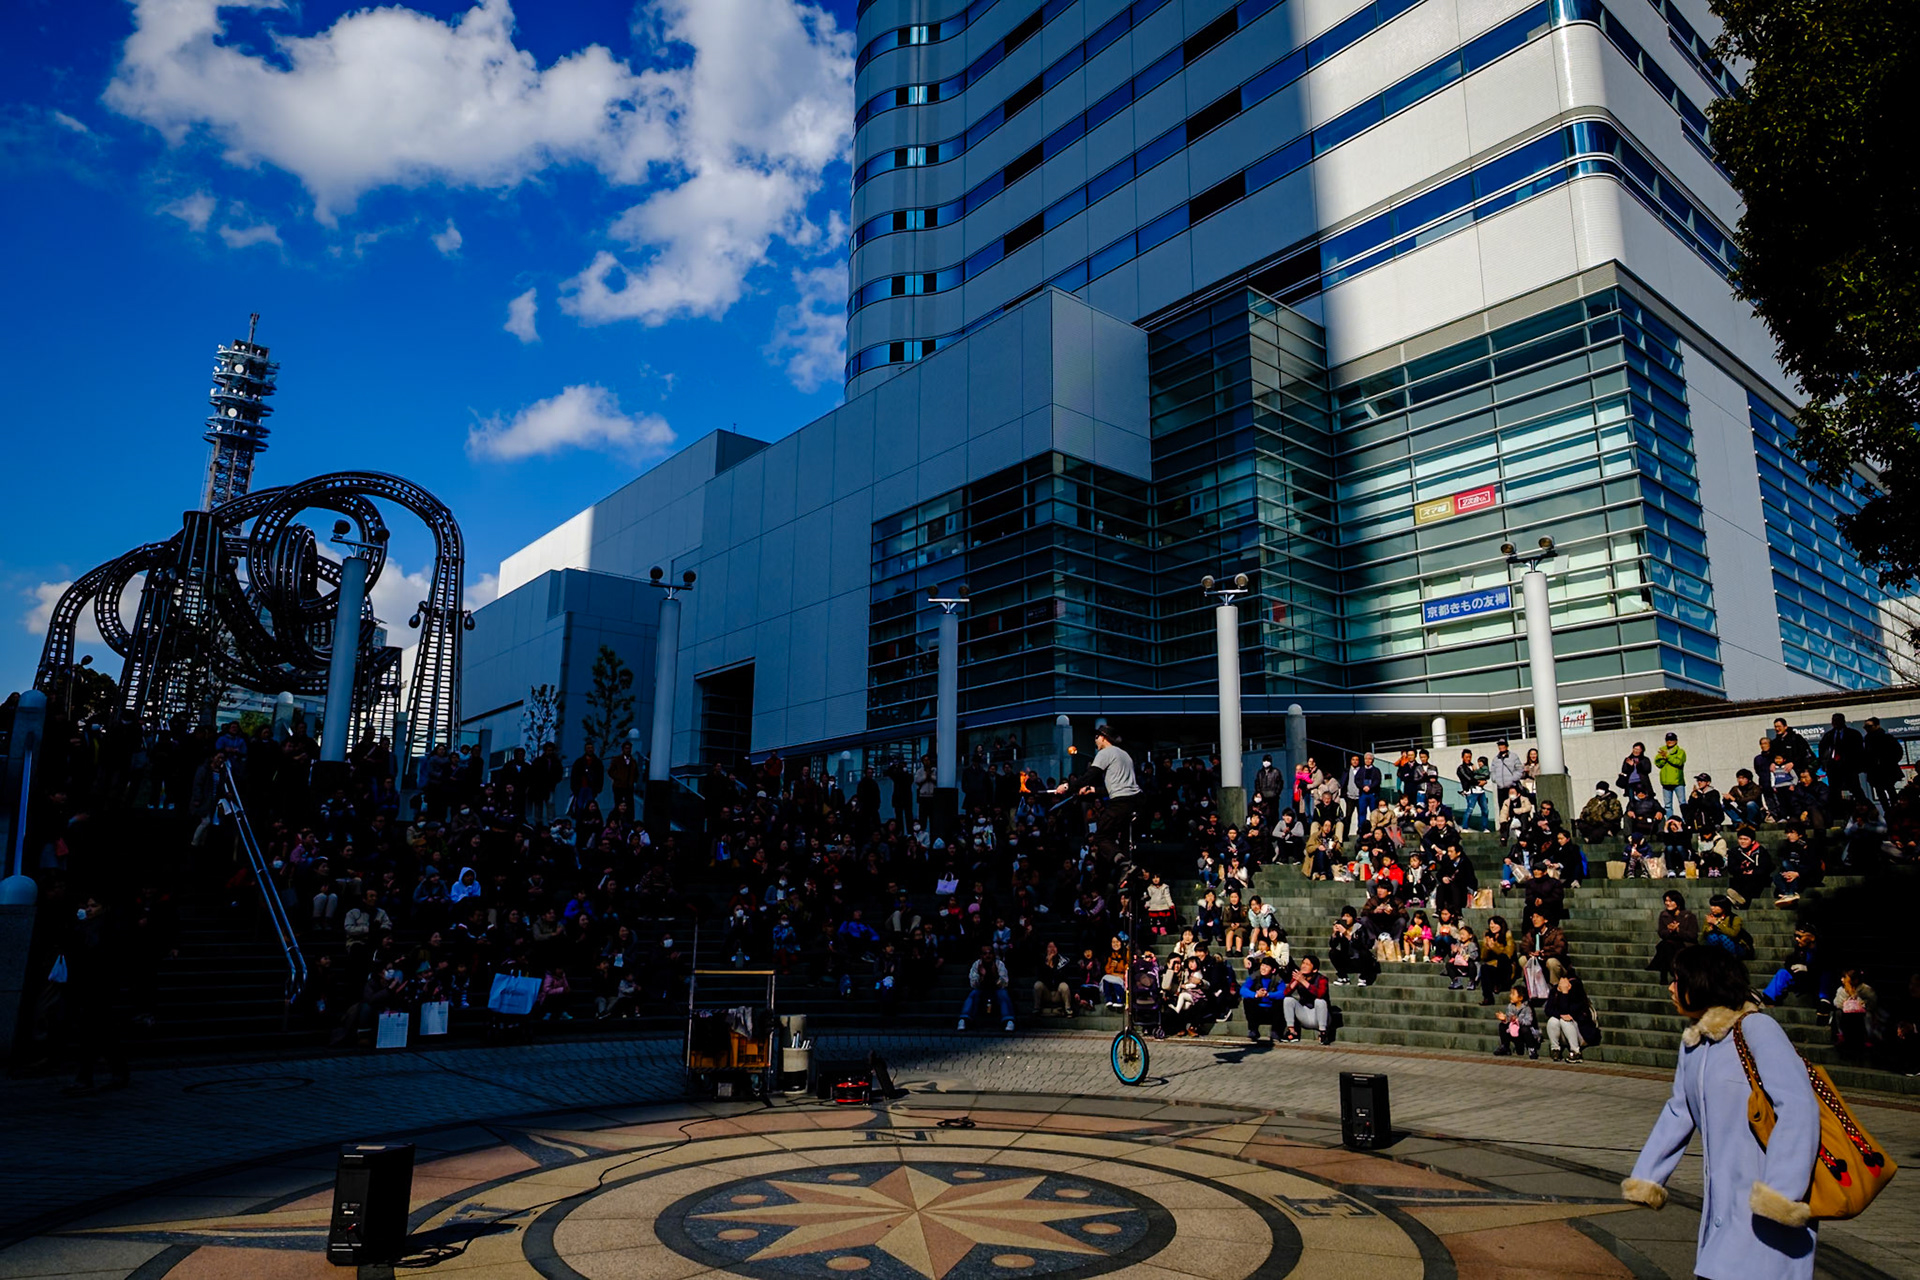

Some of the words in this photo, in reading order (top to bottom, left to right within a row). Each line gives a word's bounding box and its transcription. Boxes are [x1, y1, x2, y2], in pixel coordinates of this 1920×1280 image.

[1426, 592, 1507, 618] 京都きもの友禅
